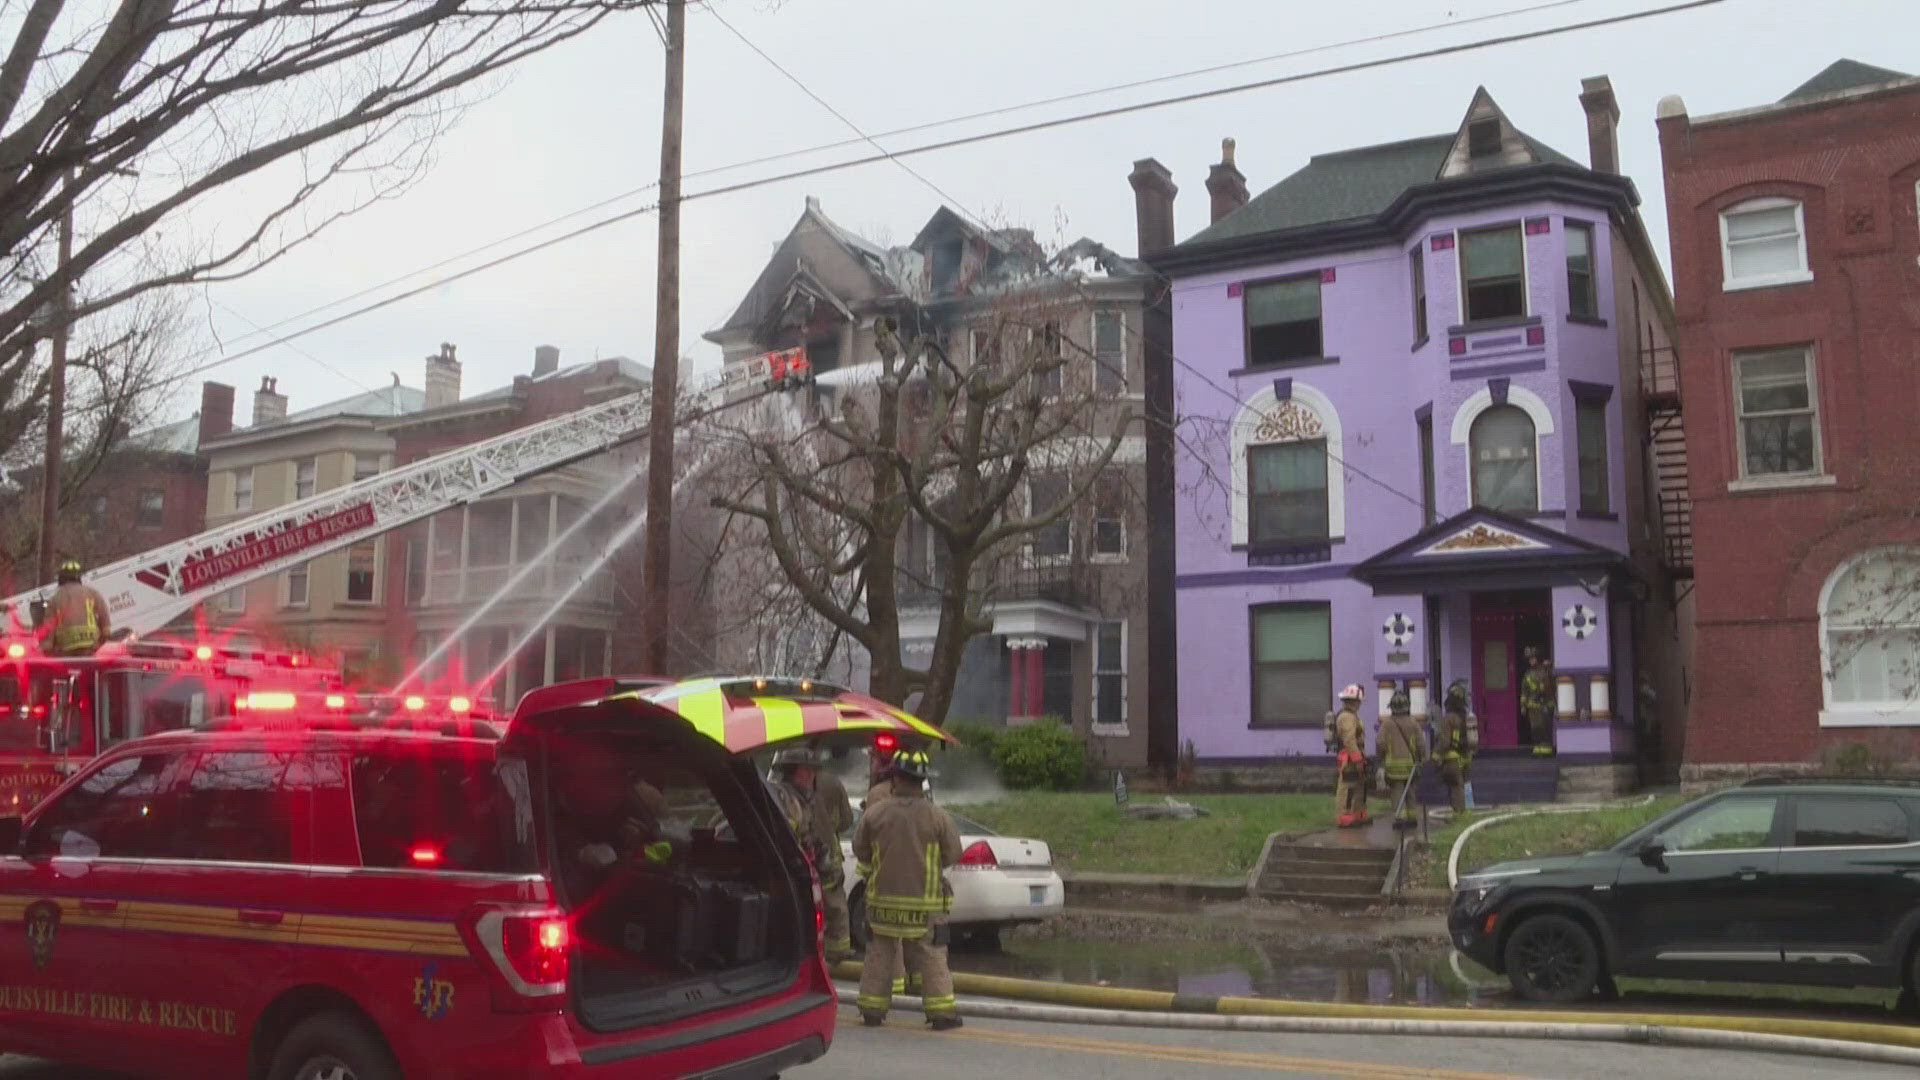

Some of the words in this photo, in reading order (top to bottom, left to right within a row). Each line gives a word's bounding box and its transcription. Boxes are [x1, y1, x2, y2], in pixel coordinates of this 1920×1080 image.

[187, 540, 271, 584] LOUISVILLE
[275, 530, 305, 554] FIRE
[307, 528, 319, 541] &
[320, 507, 371, 537] RESCUE
[90, 992, 133, 1022] FIRE
[138, 1000, 153, 1025] &
[159, 1002, 236, 1036] RESCUE
